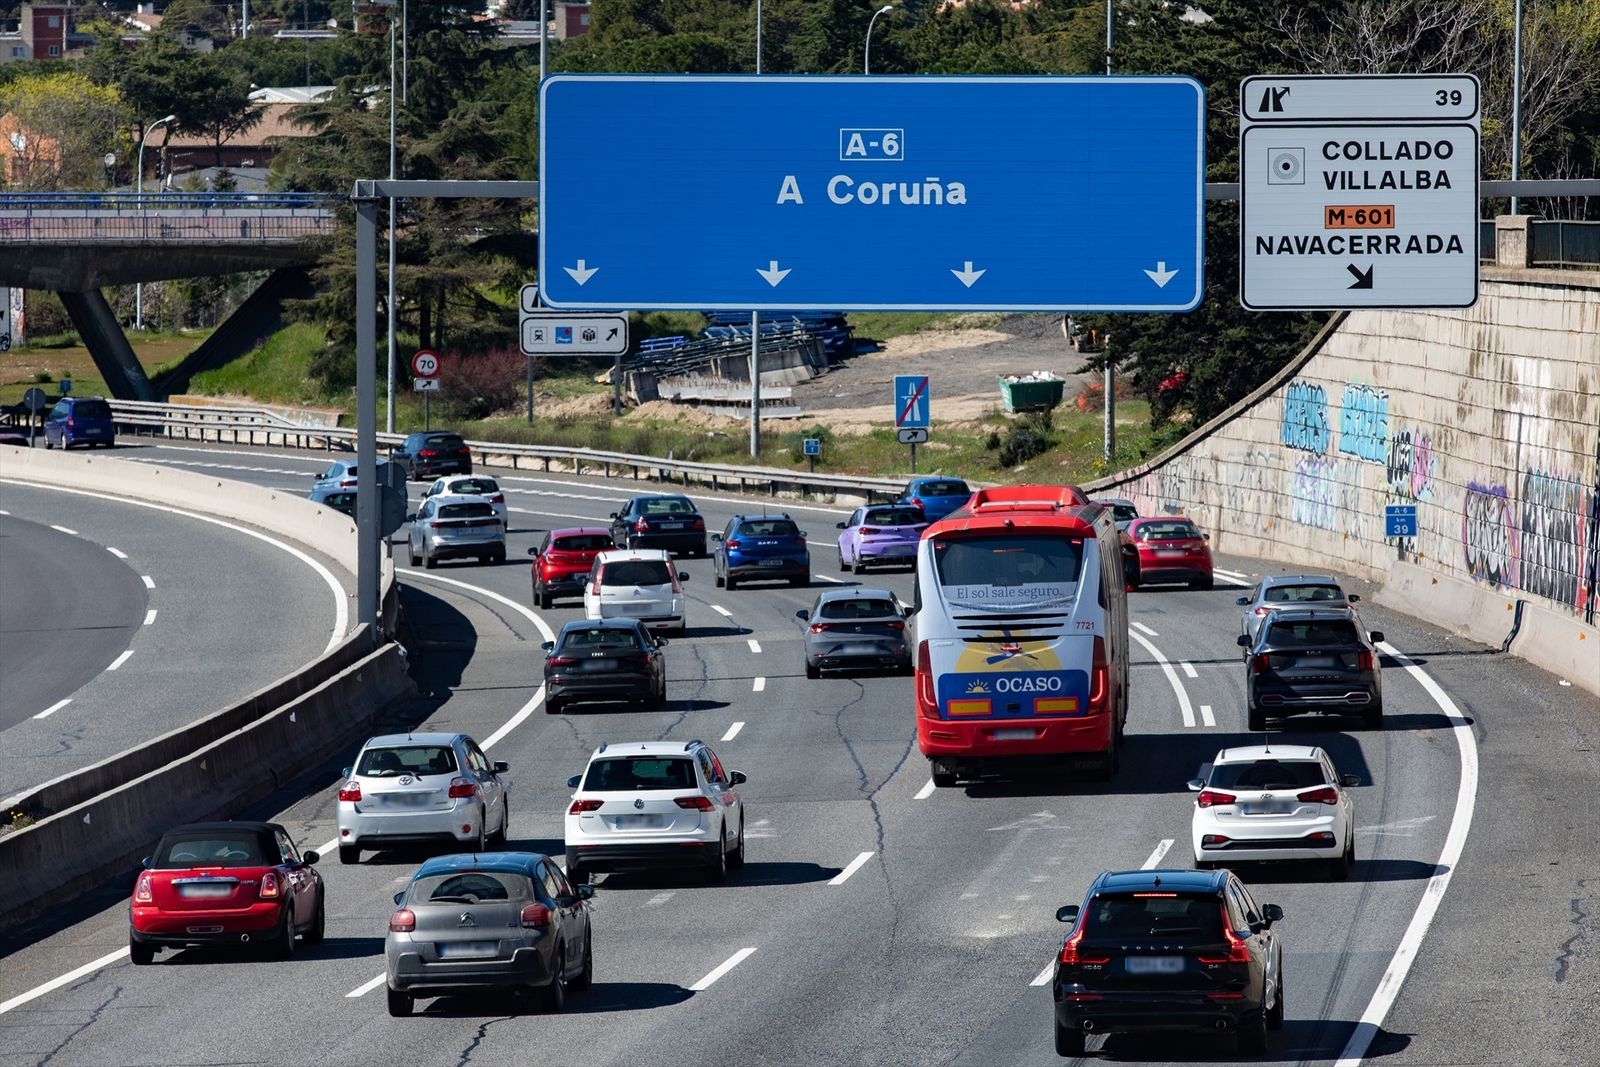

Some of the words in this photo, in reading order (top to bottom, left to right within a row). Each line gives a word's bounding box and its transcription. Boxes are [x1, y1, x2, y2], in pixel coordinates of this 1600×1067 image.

[1435, 89, 1462, 107] 39
[845, 133, 899, 156] A-6
[1322, 140, 1454, 161] COLLADO
[1322, 169, 1452, 190] VILLALBA
[776, 175, 804, 204] A
[827, 174, 967, 205] Coruña
[1328, 208, 1391, 225] M-601
[1256, 234, 1464, 255] NAVACERRADA
[420, 359, 435, 369] 70
[1393, 524, 1409, 534] 39
[957, 587, 968, 599] El
[971, 586, 989, 599] sol
[992, 585, 1016, 598] sale
[1076, 621, 1095, 630] 7721
[995, 676, 1062, 693] OCASO
